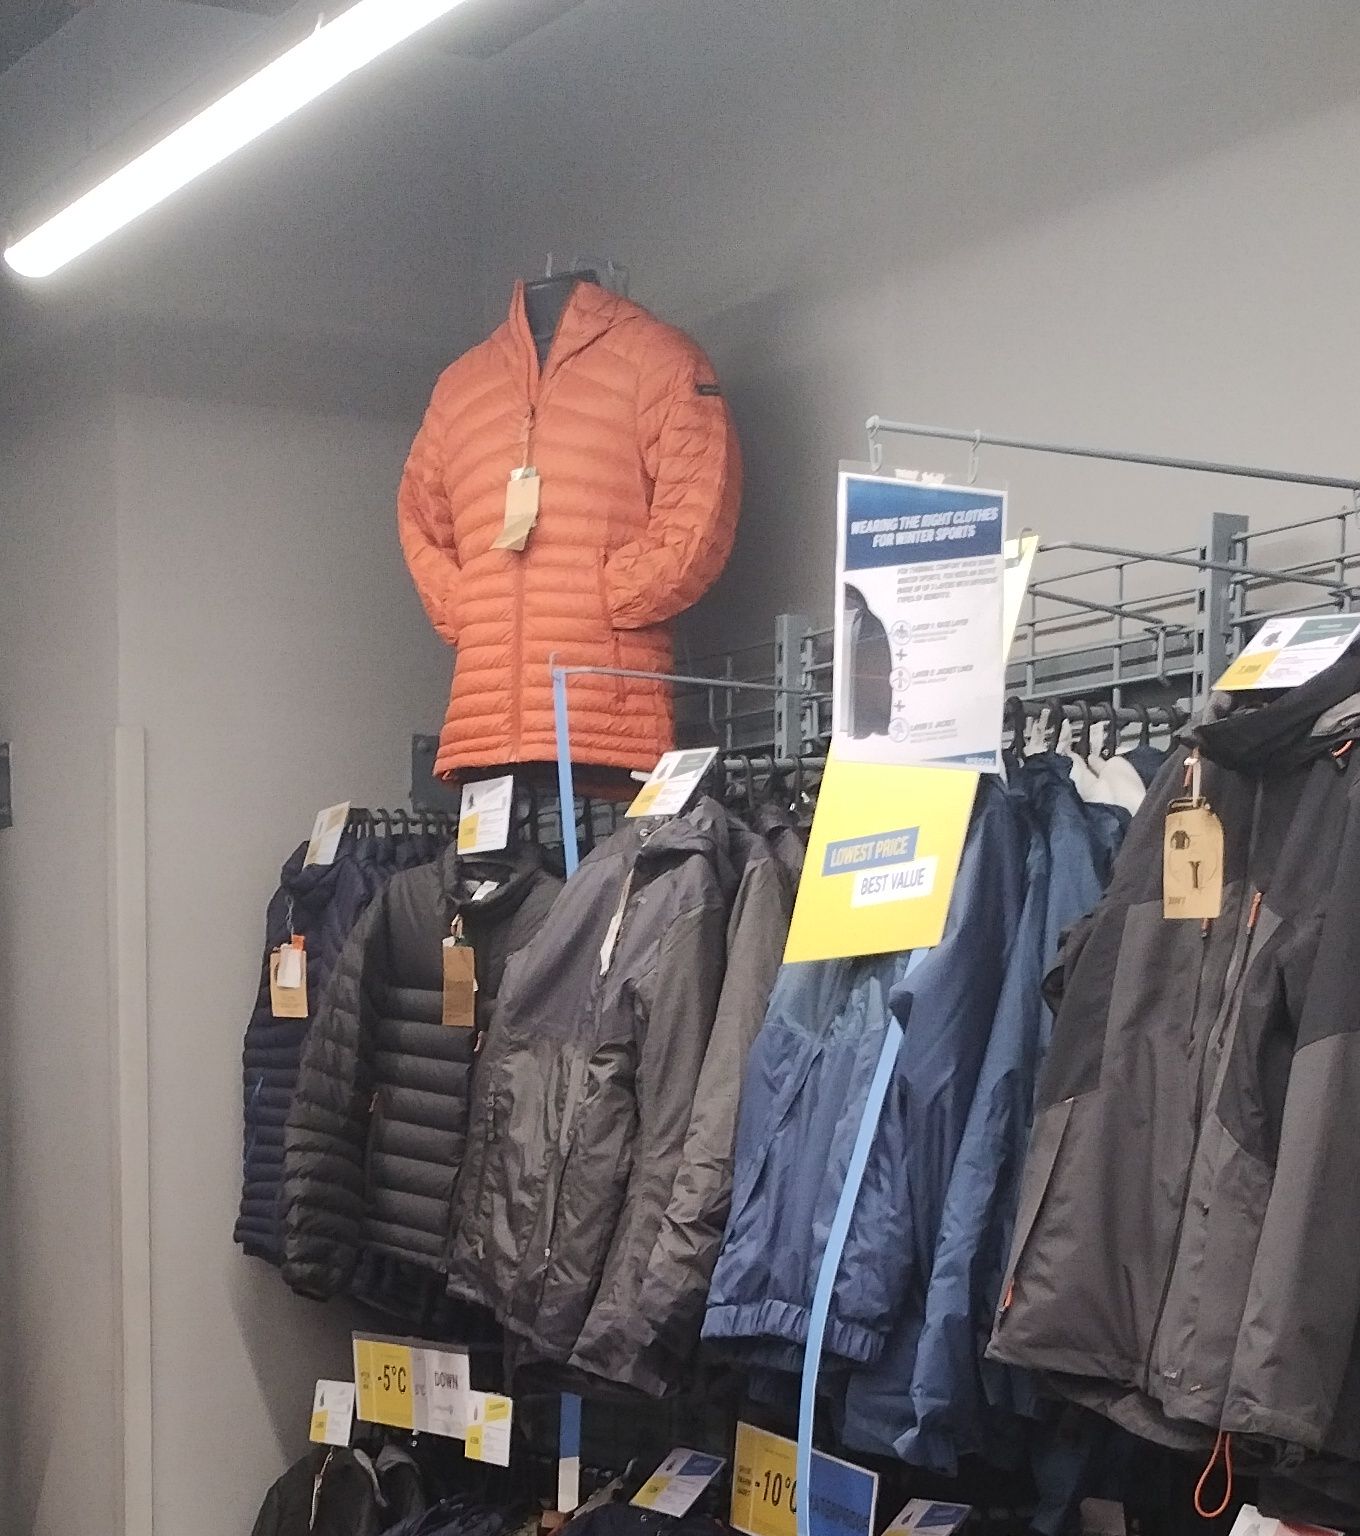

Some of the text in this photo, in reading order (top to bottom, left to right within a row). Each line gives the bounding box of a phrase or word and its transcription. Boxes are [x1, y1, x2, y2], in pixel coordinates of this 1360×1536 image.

[851, 507, 1000, 535] WEARING THE RIGHT CLOTHES
[872, 525, 976, 548] FOR WINTER SPORTS
[830, 835, 910, 868] LOWEST PRICE
[860, 867, 927, 896] BEST VALUE
[377, 1364, 406, 1393] -5°C
[434, 1371, 458, 1390] DOWN
